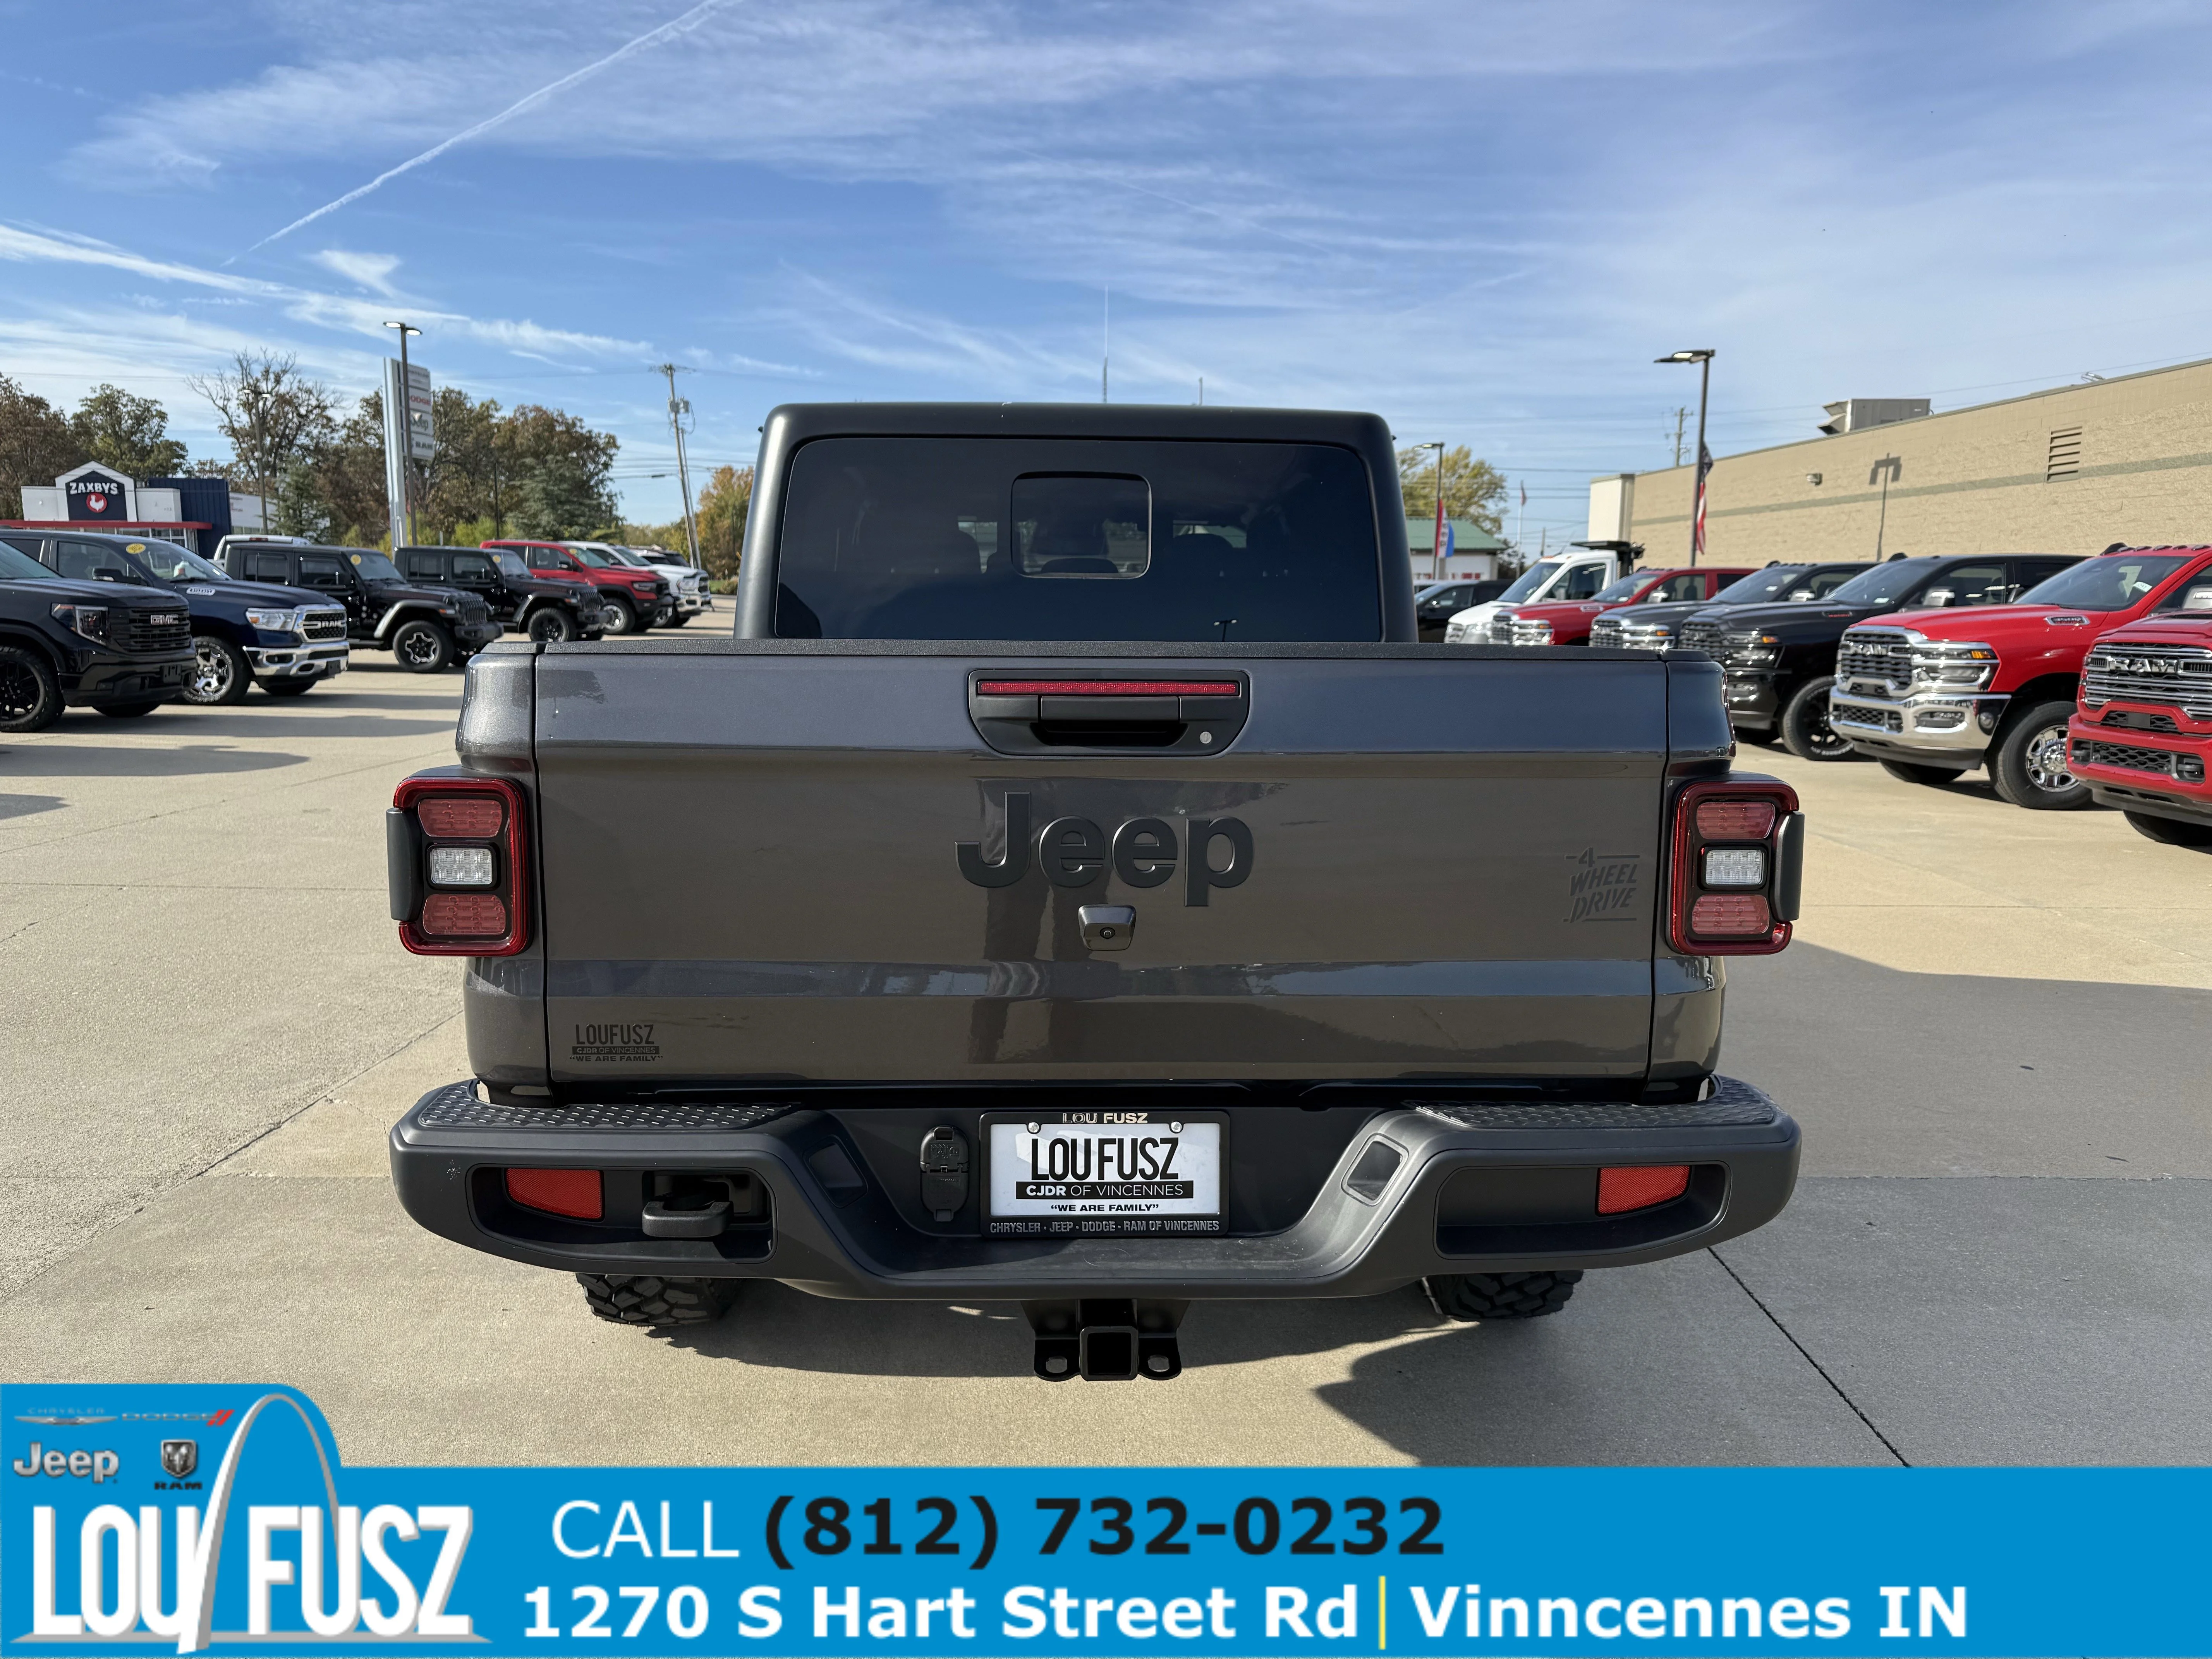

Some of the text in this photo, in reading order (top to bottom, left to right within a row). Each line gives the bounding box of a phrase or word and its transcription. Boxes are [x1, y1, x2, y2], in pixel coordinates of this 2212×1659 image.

[409, 394, 431, 406] ODGE
[69, 482, 118, 495] ZAXBYS
[150, 614, 179, 625] GMC
[1850, 643, 1887, 655] RAM
[2110, 658, 2177, 673] RAM
[955, 791, 1254, 907] Jeep
[1578, 847, 1595, 867] 4
[1570, 864, 1638, 896] WHEEL
[1570, 887, 1637, 924] DRIVE
[1062, 1113, 1148, 1124] LOU FUSZ
[1031, 1137, 1179, 1181] LOU FUSZ
[1026, 1184, 1183, 1196] CJDR OF VINCENNES
[990, 1220, 1219, 1233] CHRYSLER JEEP DODGE RAM OF VINCENNES
